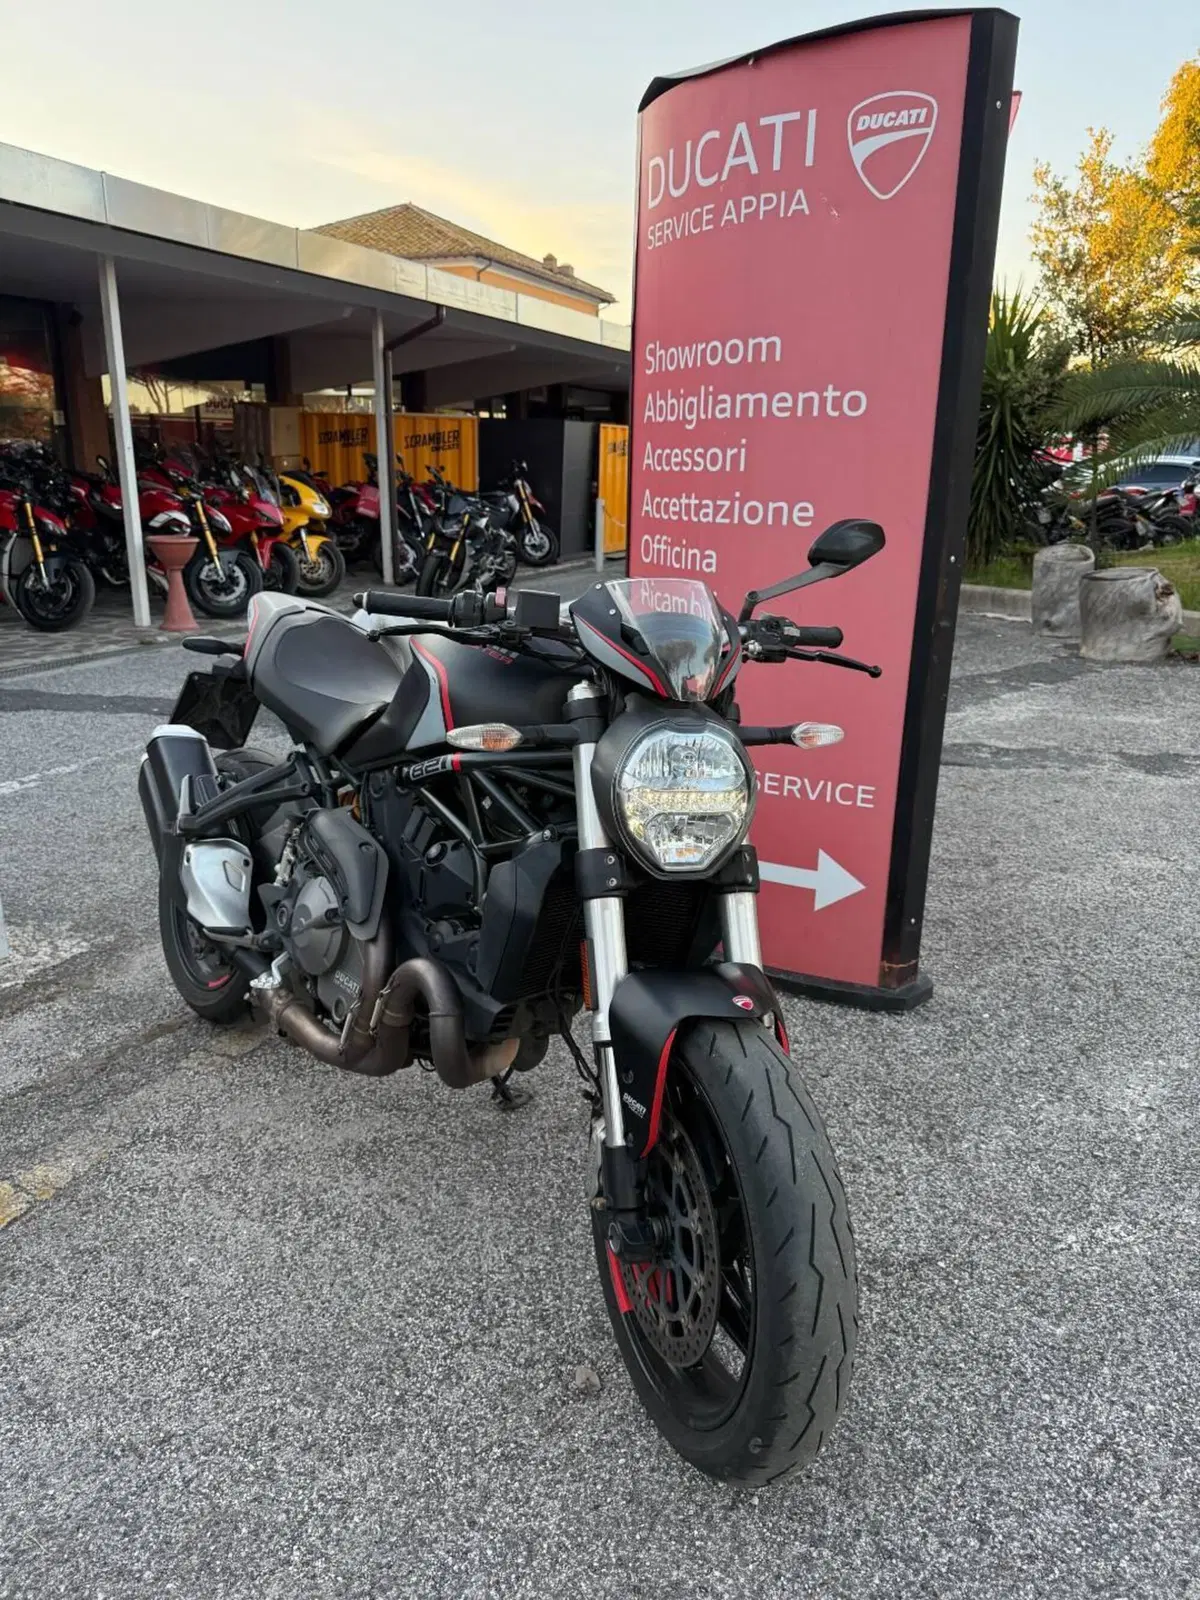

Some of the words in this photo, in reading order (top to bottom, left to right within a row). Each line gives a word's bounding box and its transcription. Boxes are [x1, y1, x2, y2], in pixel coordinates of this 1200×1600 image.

[855, 107, 928, 131] DUCATI
[647, 108, 818, 209] DUCATI
[647, 203, 715, 250] SERVICE
[720, 188, 810, 227] APPIA
[645, 334, 782, 375] Showroom
[643, 383, 868, 430] Abbigliamento
[404, 429, 460, 450] SCRAMBLER
[642, 438, 747, 472] Accessori
[641, 488, 815, 527] Accettazione
[640, 533, 717, 573] Officina
[623, 1092, 647, 1115] DUCATI
